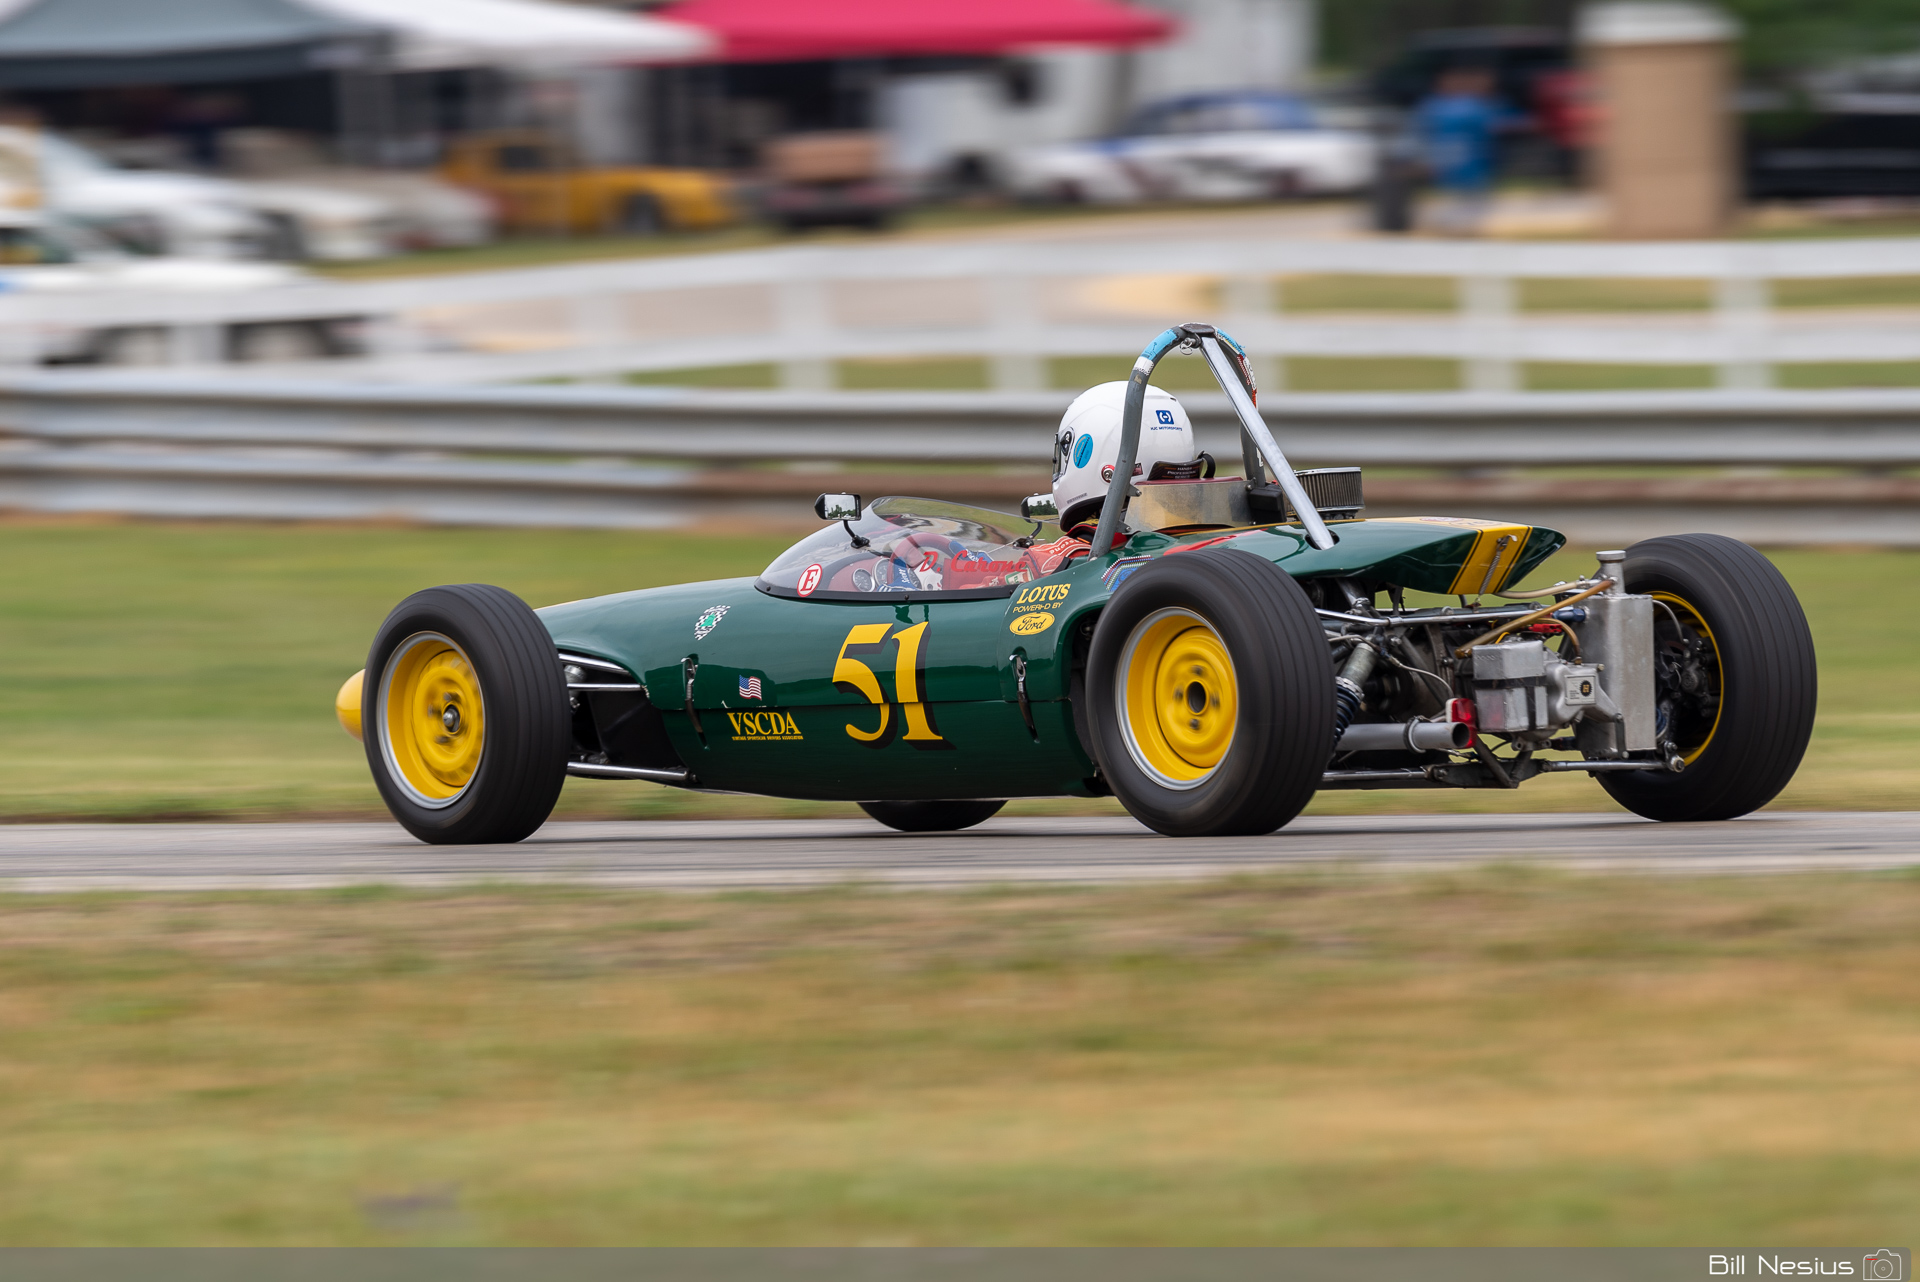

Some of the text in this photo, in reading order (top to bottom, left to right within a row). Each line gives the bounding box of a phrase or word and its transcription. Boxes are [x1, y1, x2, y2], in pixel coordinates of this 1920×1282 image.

[950, 549, 1028, 573] Carone
[800, 569, 819, 592] E
[1016, 583, 1071, 604] LOTUS
[1051, 601, 1064, 609] BY
[1017, 615, 1047, 631] Ford
[832, 621, 945, 742] 51
[727, 712, 801, 735] VSCDA
